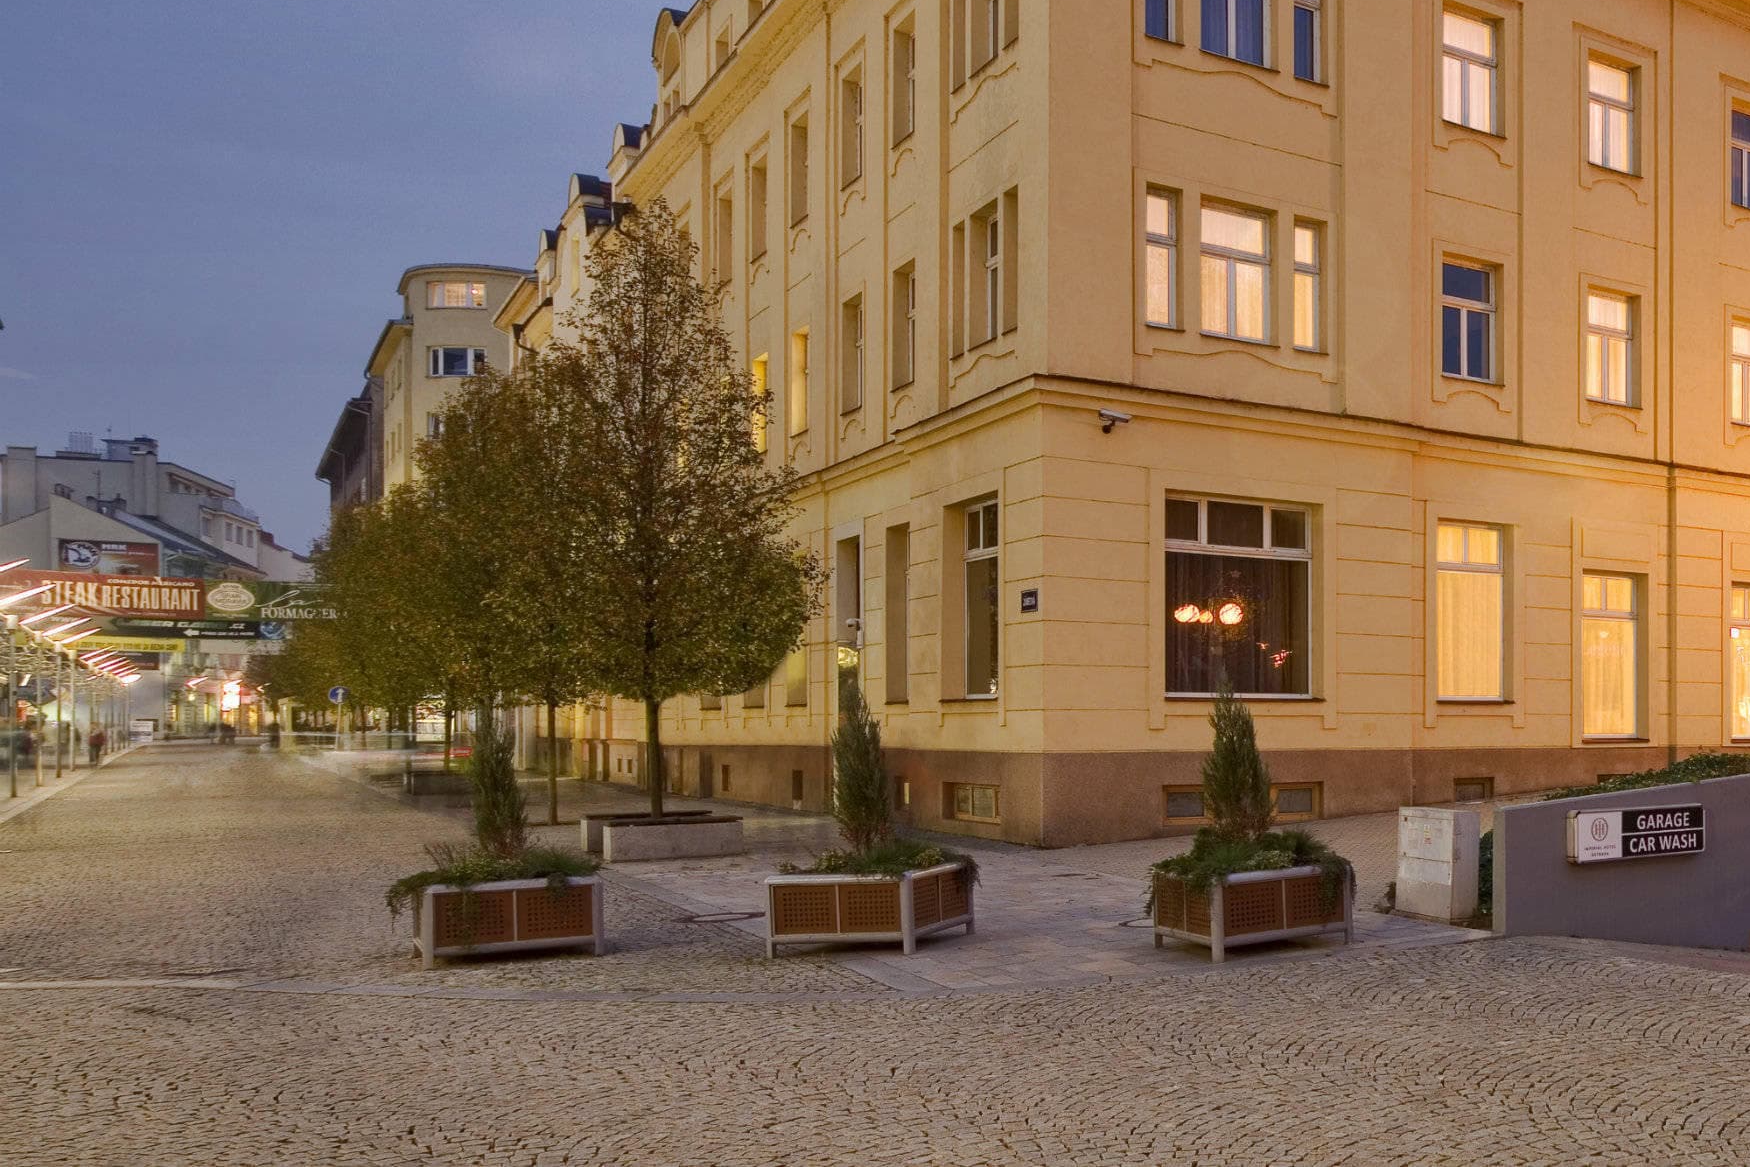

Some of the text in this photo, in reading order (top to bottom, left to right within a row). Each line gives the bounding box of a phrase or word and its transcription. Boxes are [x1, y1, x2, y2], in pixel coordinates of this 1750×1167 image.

[41, 580, 98, 607] STEAK
[102, 585, 201, 611] RESTAURANT
[1637, 812, 1690, 830] GARAGE
[1629, 833, 1697, 853] CAR WASH
